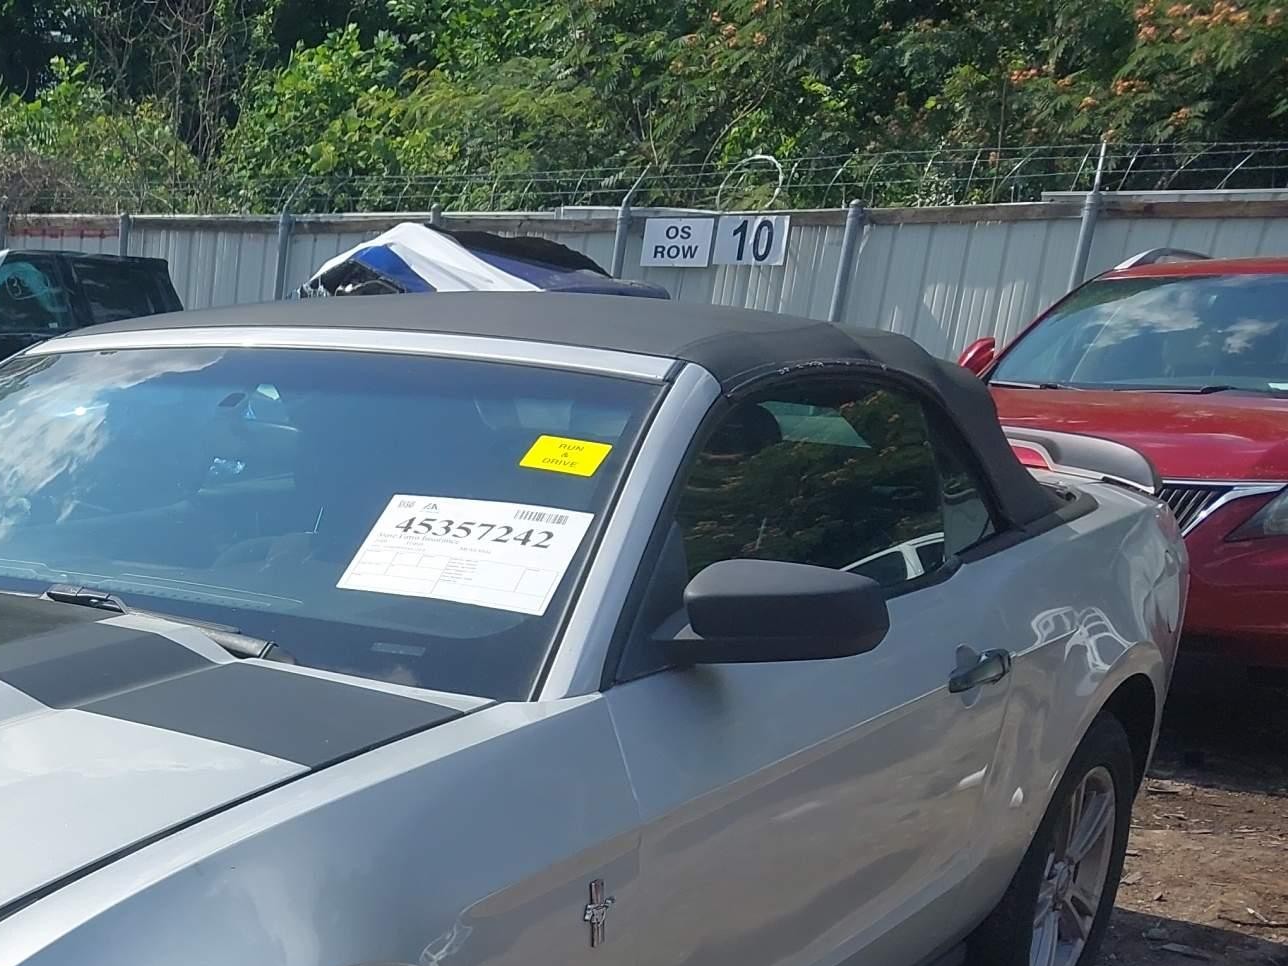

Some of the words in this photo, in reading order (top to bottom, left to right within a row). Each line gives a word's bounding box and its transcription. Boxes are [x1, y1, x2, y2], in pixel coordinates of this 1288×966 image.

[665, 225, 692, 240] OS
[732, 219, 774, 262] 10
[653, 245, 698, 259] ROW
[558, 443, 585, 452] RUN
[541, 457, 578, 468] DRIVE
[395, 516, 554, 549] 45357242
